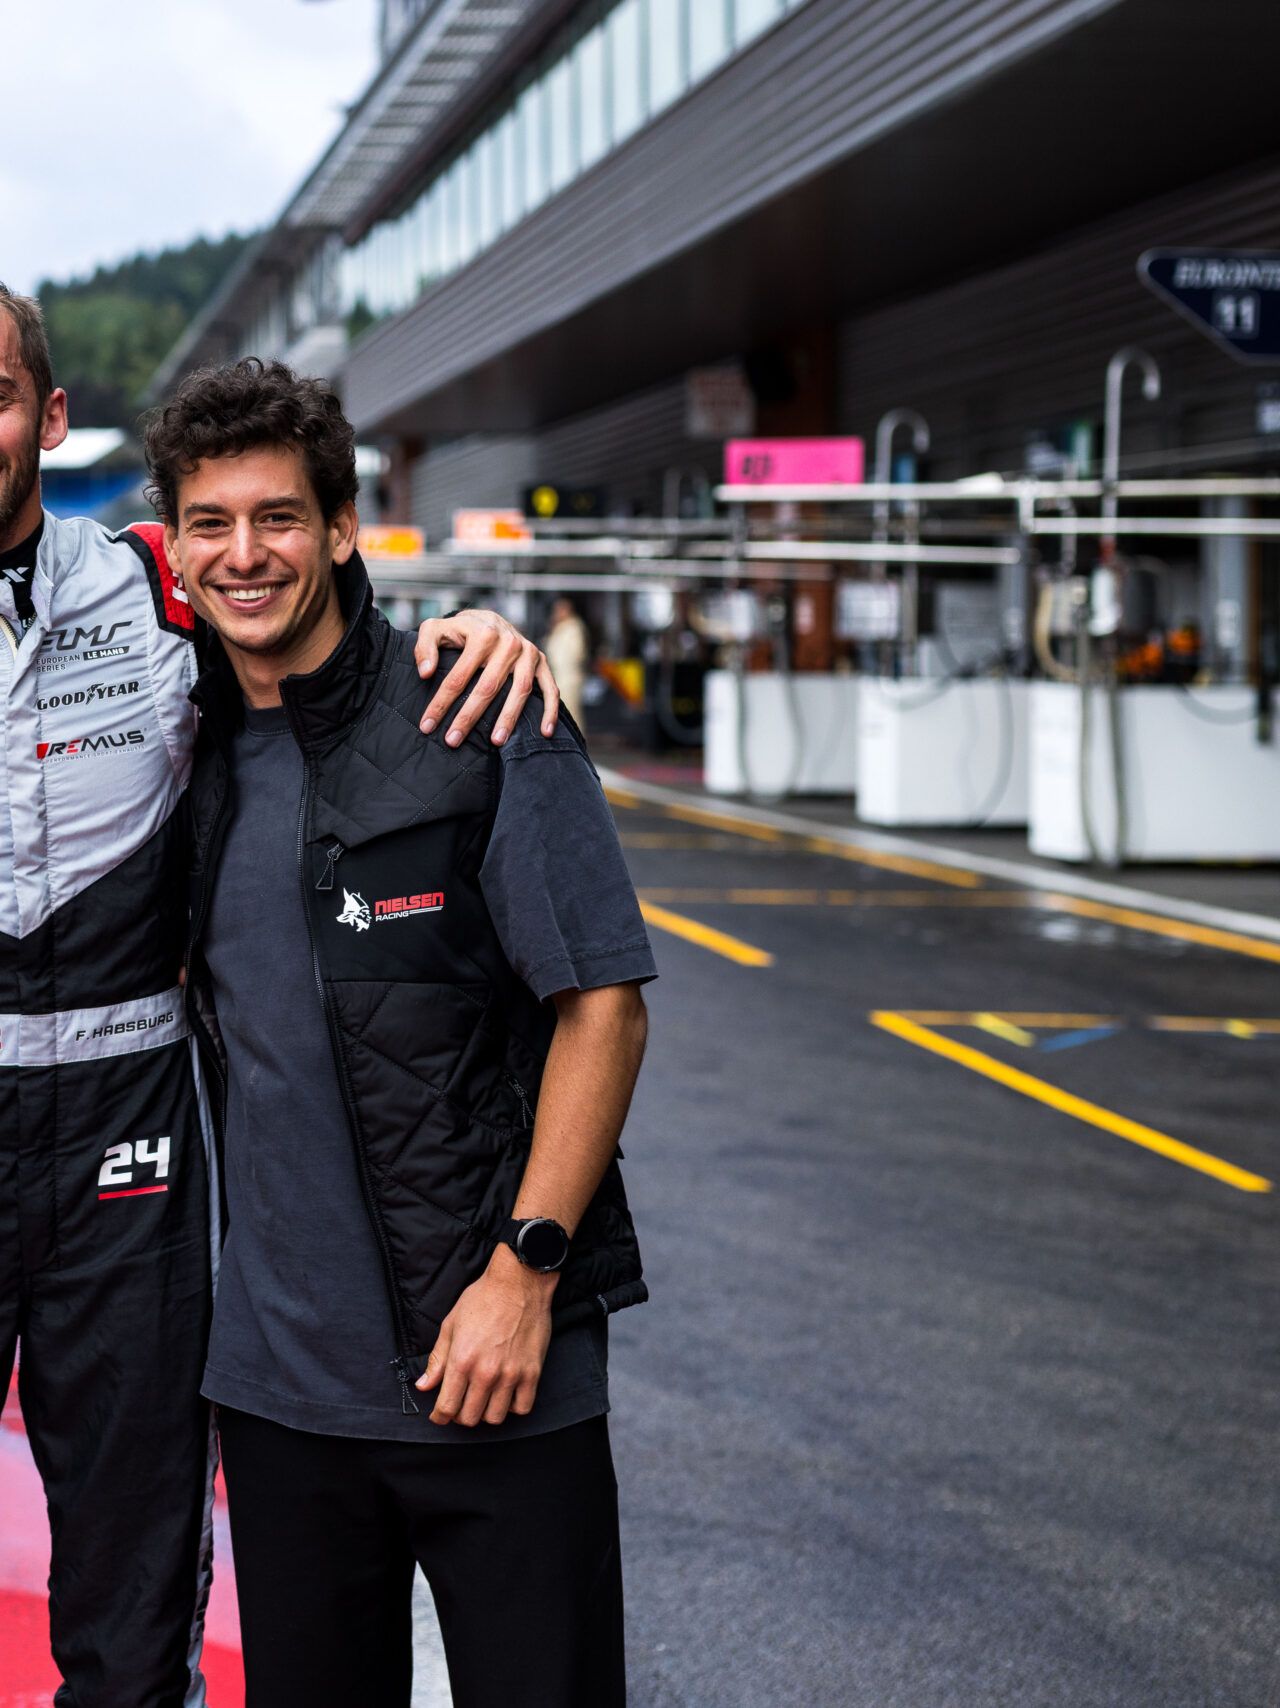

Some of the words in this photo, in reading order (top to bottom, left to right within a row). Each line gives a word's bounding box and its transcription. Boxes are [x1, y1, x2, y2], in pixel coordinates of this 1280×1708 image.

[1217, 294, 1254, 333] 11
[38, 620, 133, 653] ELMS
[36, 654, 80, 665] EUROPEAN
[87, 650, 99, 659] LE
[101, 647, 125, 658] MANS
[36, 664, 66, 673] SERIES
[36, 681, 140, 711] GOODYEAR
[375, 892, 444, 915] NIELSEN
[375, 910, 410, 922] RACING
[97, 1136, 171, 1187] 24
